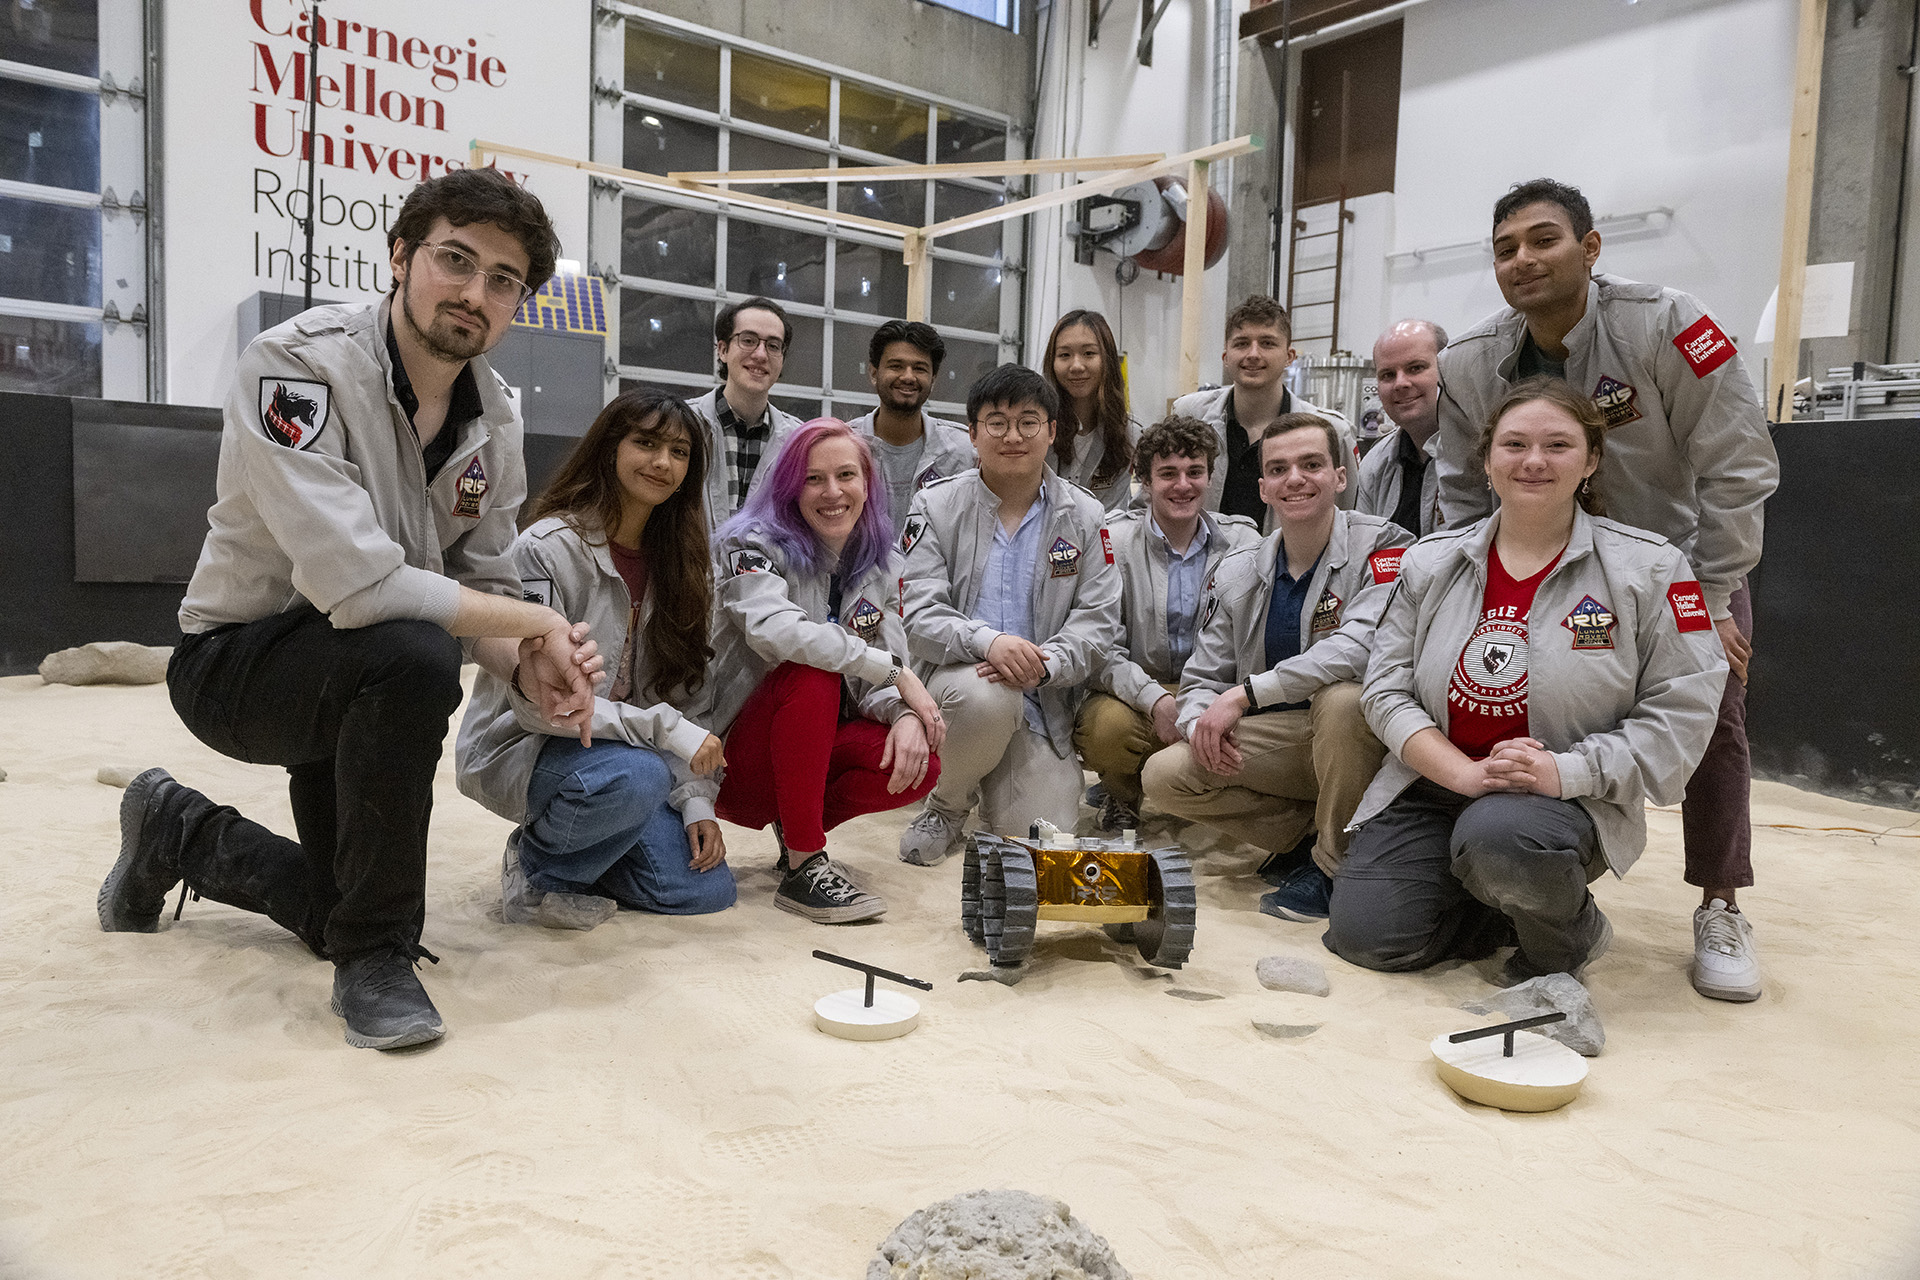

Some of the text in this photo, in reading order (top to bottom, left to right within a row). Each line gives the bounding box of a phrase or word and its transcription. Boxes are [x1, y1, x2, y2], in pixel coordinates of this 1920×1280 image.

[249, 0, 508, 92] Carnegie
[248, 39, 449, 132] Mellon
[248, 100, 530, 188] Univer
[1684, 328, 1714, 351] Carnegie
[1688, 339, 1714, 358] Mellon
[1693, 338, 1727, 364] University
[1591, 387, 1633, 411] IRIS
[460, 477, 487, 494] IRIS
[1048, 548, 1078, 562] IRIS
[1315, 598, 1338, 613] RIS
[1672, 593, 1700, 602] Carnegie
[1675, 601, 1697, 609] Mellon
[852, 611, 881, 629] IRIS
[1567, 612, 1613, 629] IRIS
[1678, 609, 1706, 618] University
[1468, 682, 1518, 696] TARTANS
[1447, 684, 1529, 717] NIVERSI
[1071, 885, 1118, 901] IRIS
